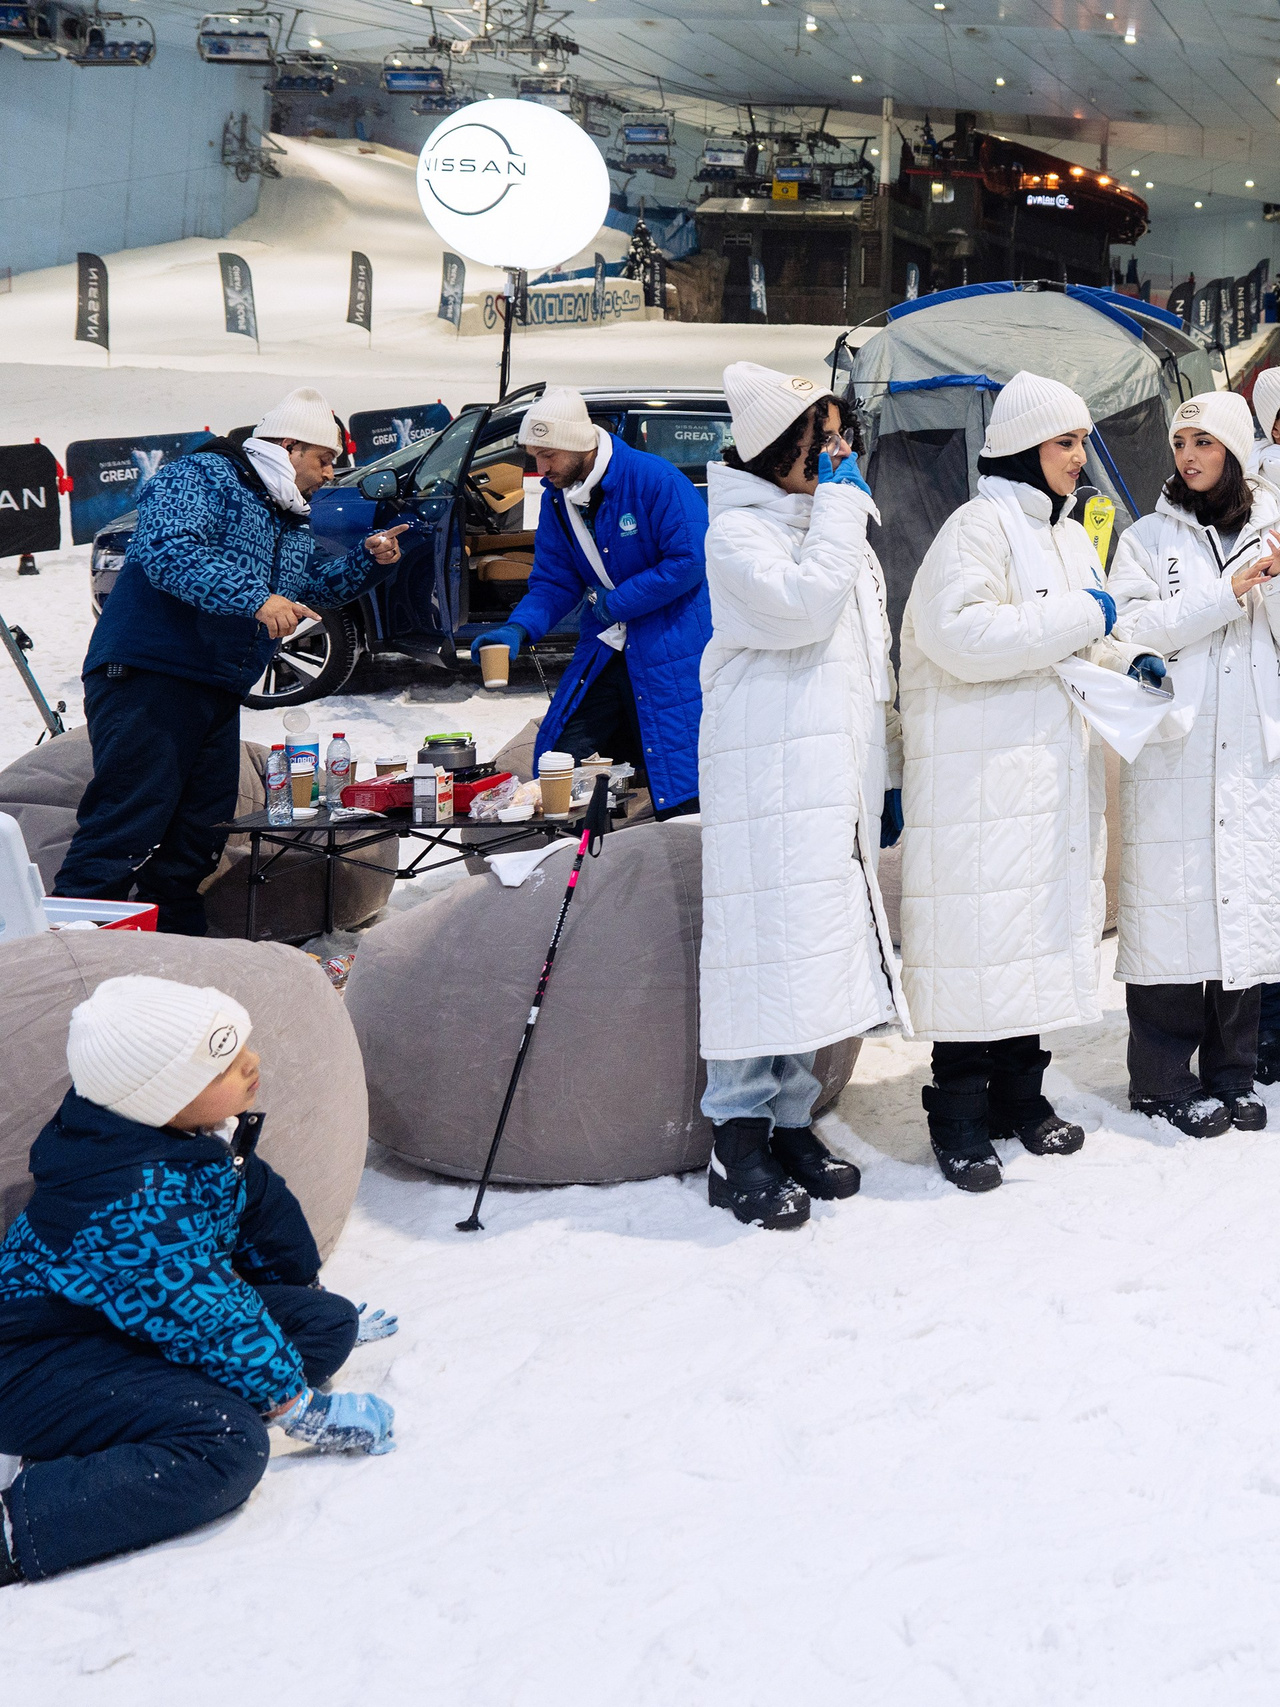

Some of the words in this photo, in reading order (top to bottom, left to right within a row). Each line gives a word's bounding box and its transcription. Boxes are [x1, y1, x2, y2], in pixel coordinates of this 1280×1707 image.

[424, 158, 526, 176] NISSAN
[545, 293, 589, 325] DUBAI
[373, 433, 398, 446] GREAT
[674, 431, 715, 441] GREAT
[100, 468, 139, 483] GREAT
[110, 1206, 167, 1240] SKI
